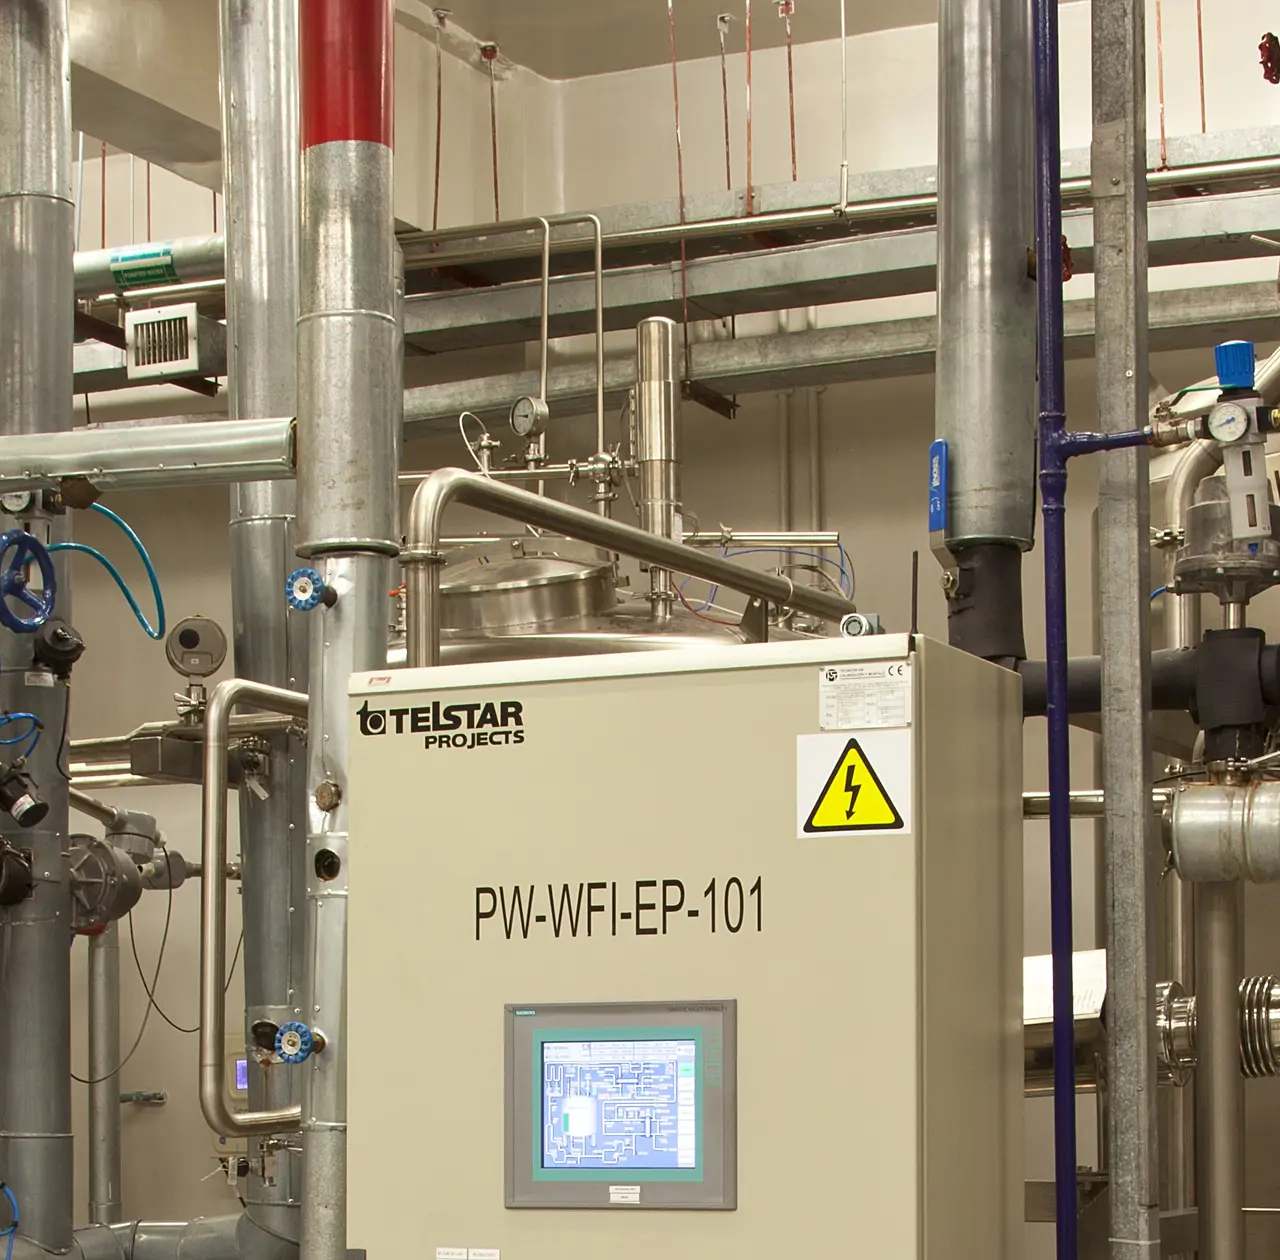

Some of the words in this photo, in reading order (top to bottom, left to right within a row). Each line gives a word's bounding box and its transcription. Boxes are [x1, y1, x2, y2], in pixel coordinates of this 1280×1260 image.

[390, 701, 524, 735] TELSTAR
[424, 729, 525, 750] PROJECTS
[475, 875, 763, 941] PW-WFI-EP-101
